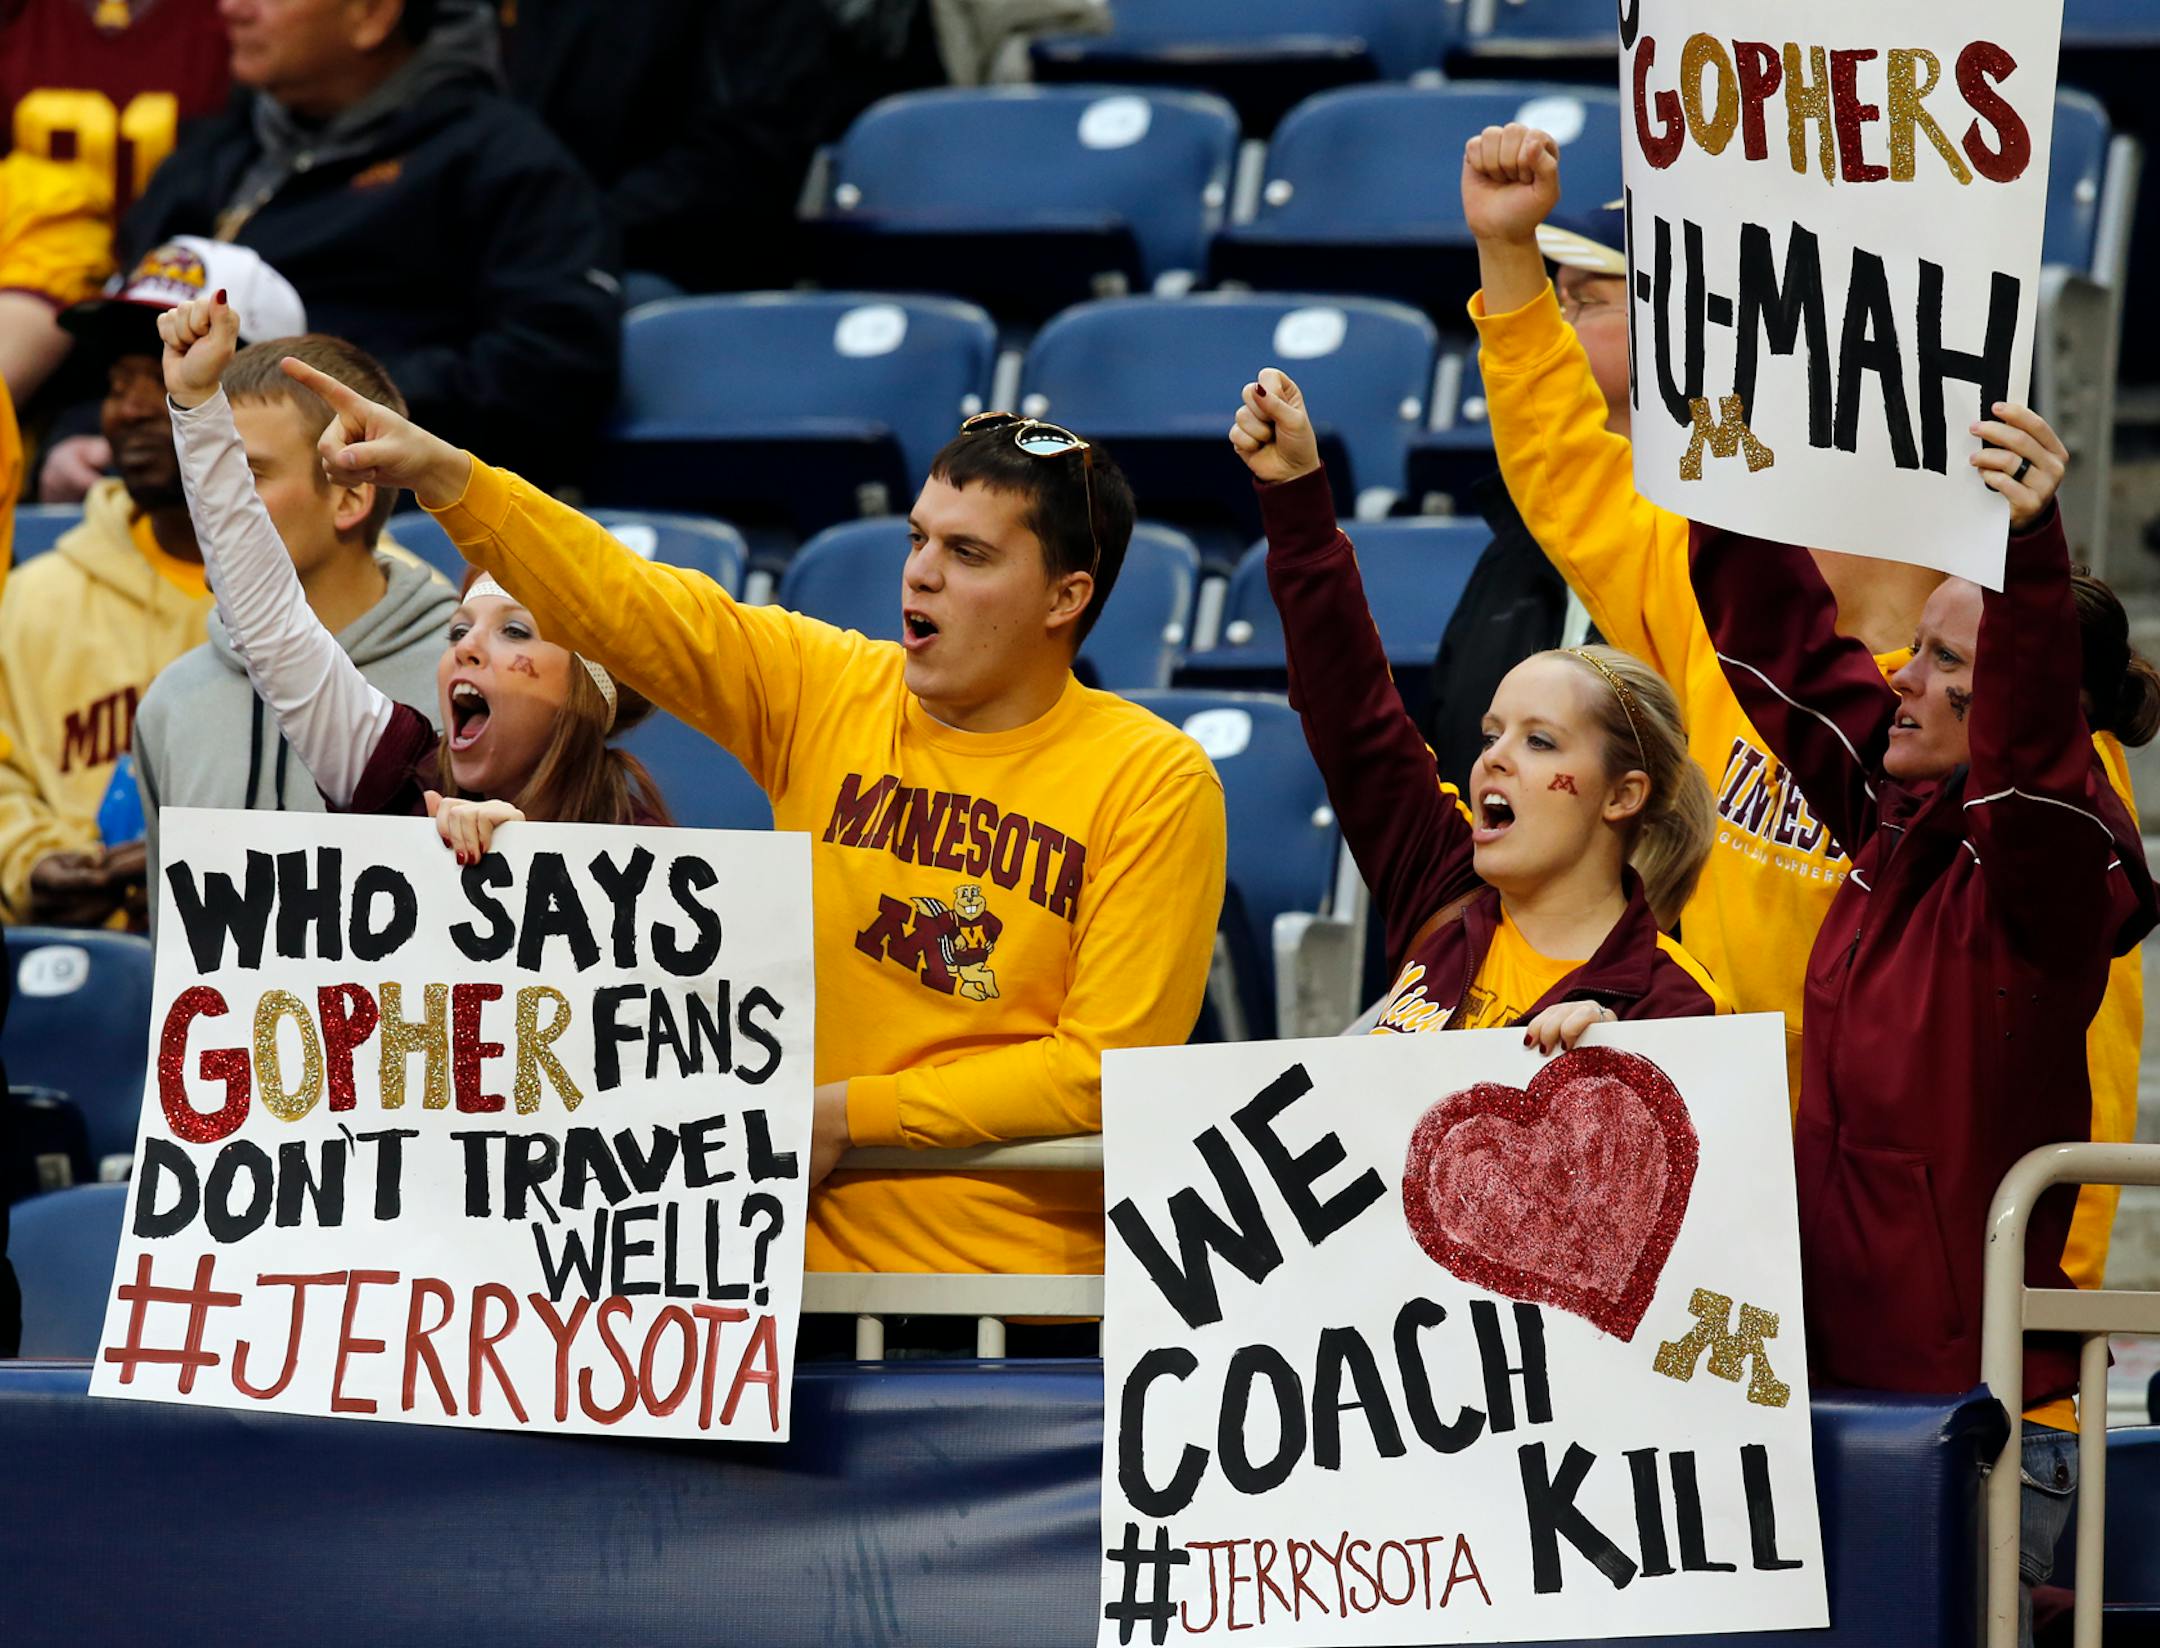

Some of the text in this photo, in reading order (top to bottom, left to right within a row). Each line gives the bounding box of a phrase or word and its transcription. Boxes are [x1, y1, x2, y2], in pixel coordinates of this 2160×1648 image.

[1633, 32, 2032, 186] GOPHERS
[166, 844, 722, 976] WHO SAYS
[822, 772, 1087, 925] MINNESOTA
[157, 979, 786, 1144] GOPHER FANS
[132, 1109, 800, 1244] DON'T TRAVEL
[532, 1192, 785, 1306] WELL?
[1108, 1063, 1388, 1330] WE
[104, 1253, 781, 1432] #JERRYSOTA
[1118, 1297, 1554, 1518] COACH
[1105, 1521, 1492, 1647] #JERRYSOTA
[1517, 1441, 1804, 1595] KILL
